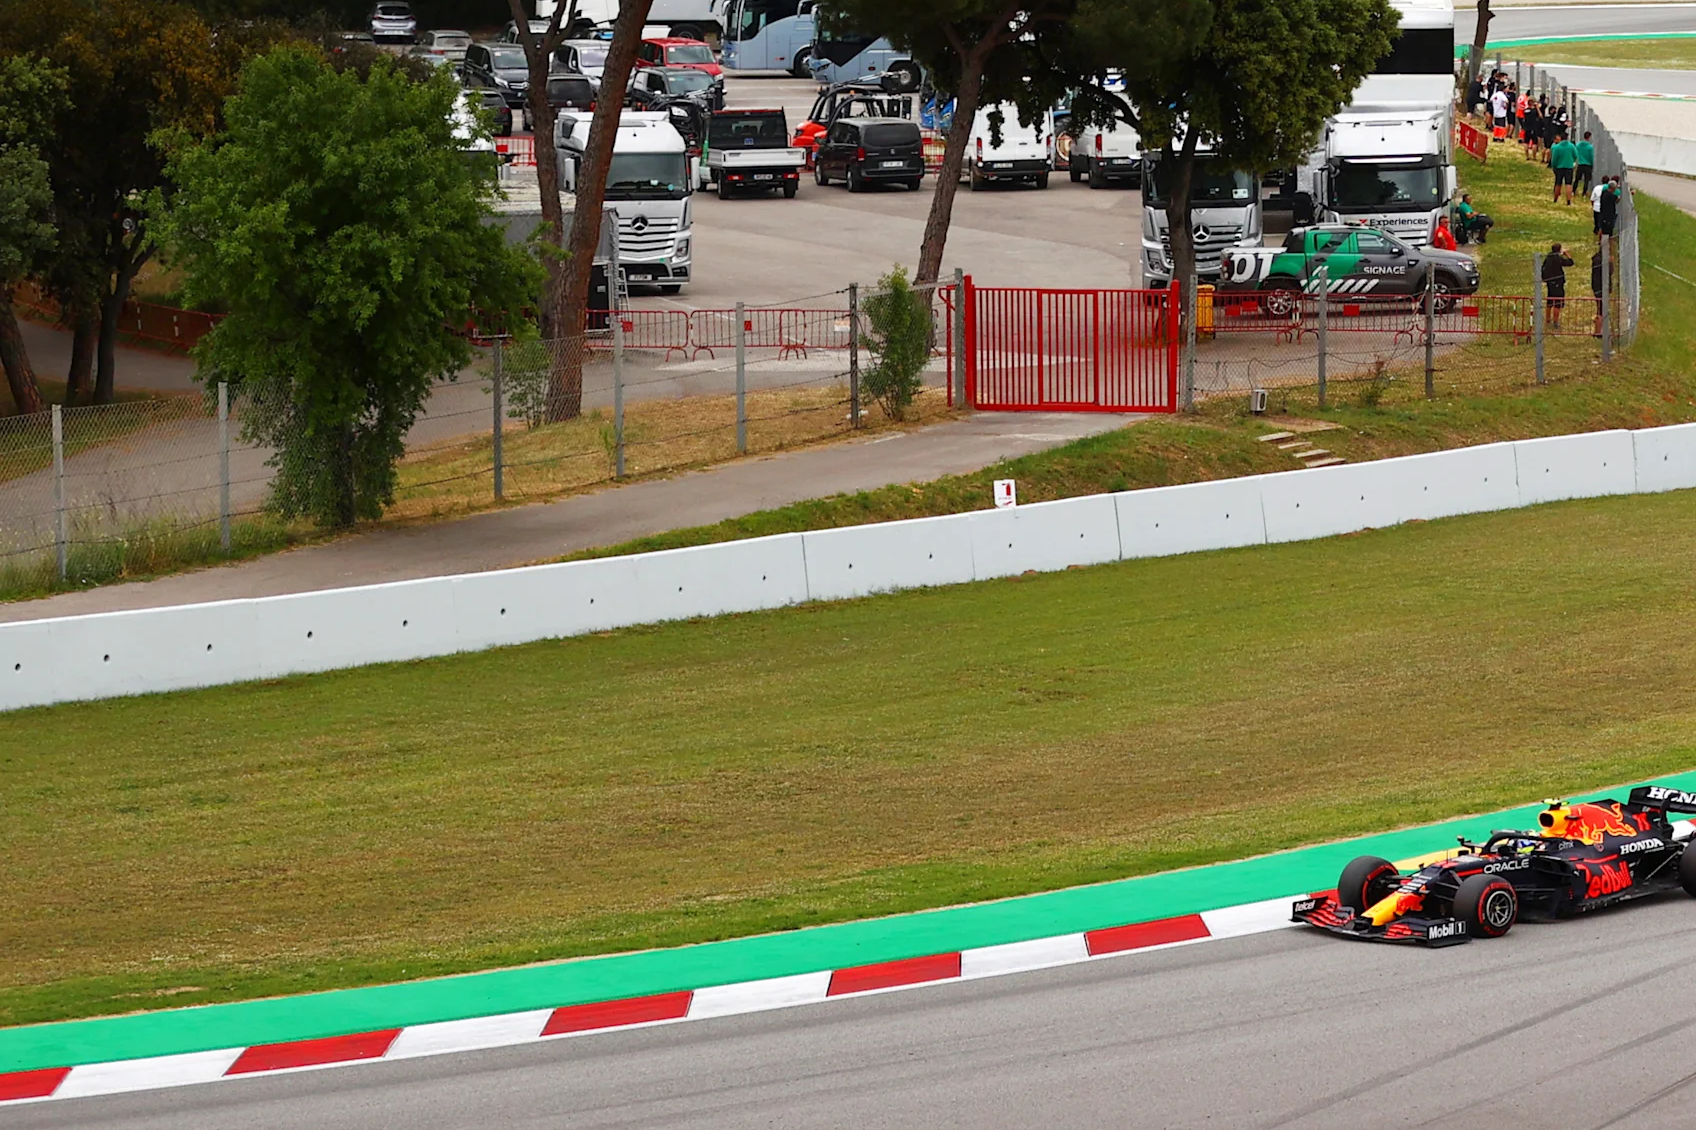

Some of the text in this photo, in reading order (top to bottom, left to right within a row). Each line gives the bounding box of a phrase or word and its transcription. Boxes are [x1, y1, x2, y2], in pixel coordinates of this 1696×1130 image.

[1369, 217, 1429, 227] Experiences
[1363, 266, 1406, 275] SIGNAGE
[1619, 837, 1664, 855] HONDA
[1483, 858, 1530, 875] ORACLE
[1294, 899, 1316, 913] telcel
[1428, 922, 1454, 940] Mobil
